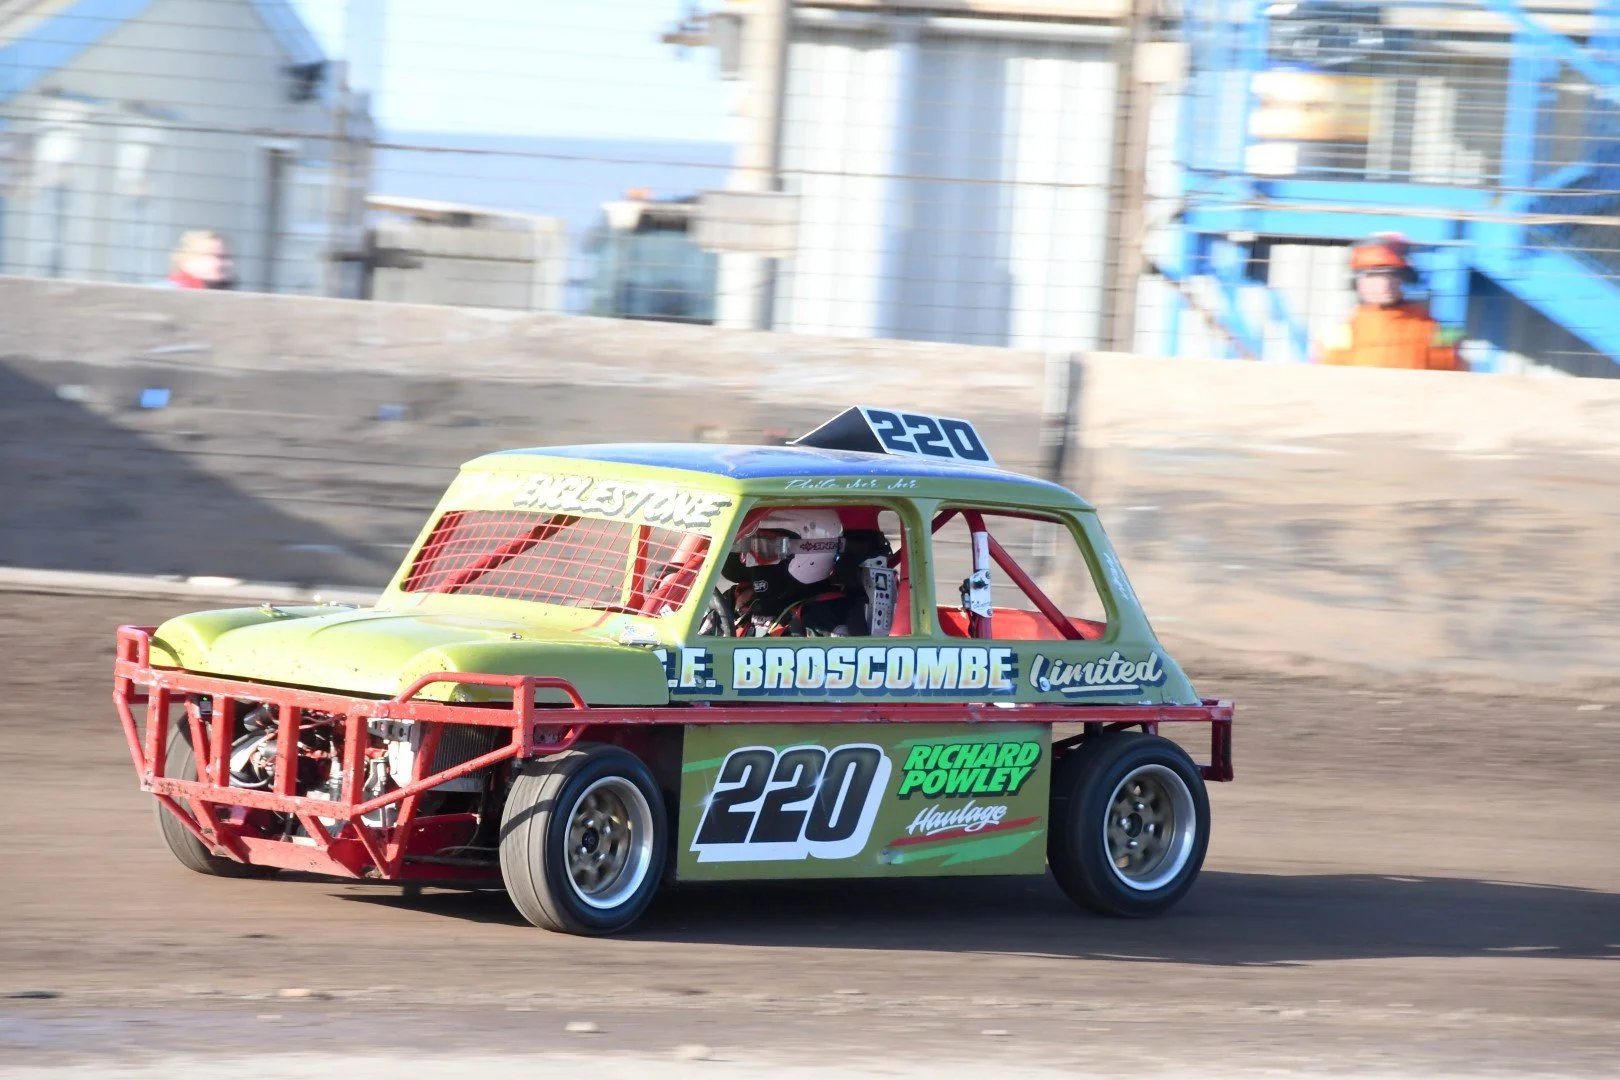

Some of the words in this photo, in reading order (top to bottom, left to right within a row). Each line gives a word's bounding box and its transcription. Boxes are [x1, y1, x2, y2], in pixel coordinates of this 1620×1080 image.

[866, 409, 990, 462] 220
[732, 646, 1016, 691] BROSCOMBE
[1030, 651, 1164, 691] Limited
[902, 741, 1042, 772] RICHARD
[690, 743, 889, 857] 220
[898, 766, 1034, 798] POWLEY
[905, 800, 1008, 836] Haulage
